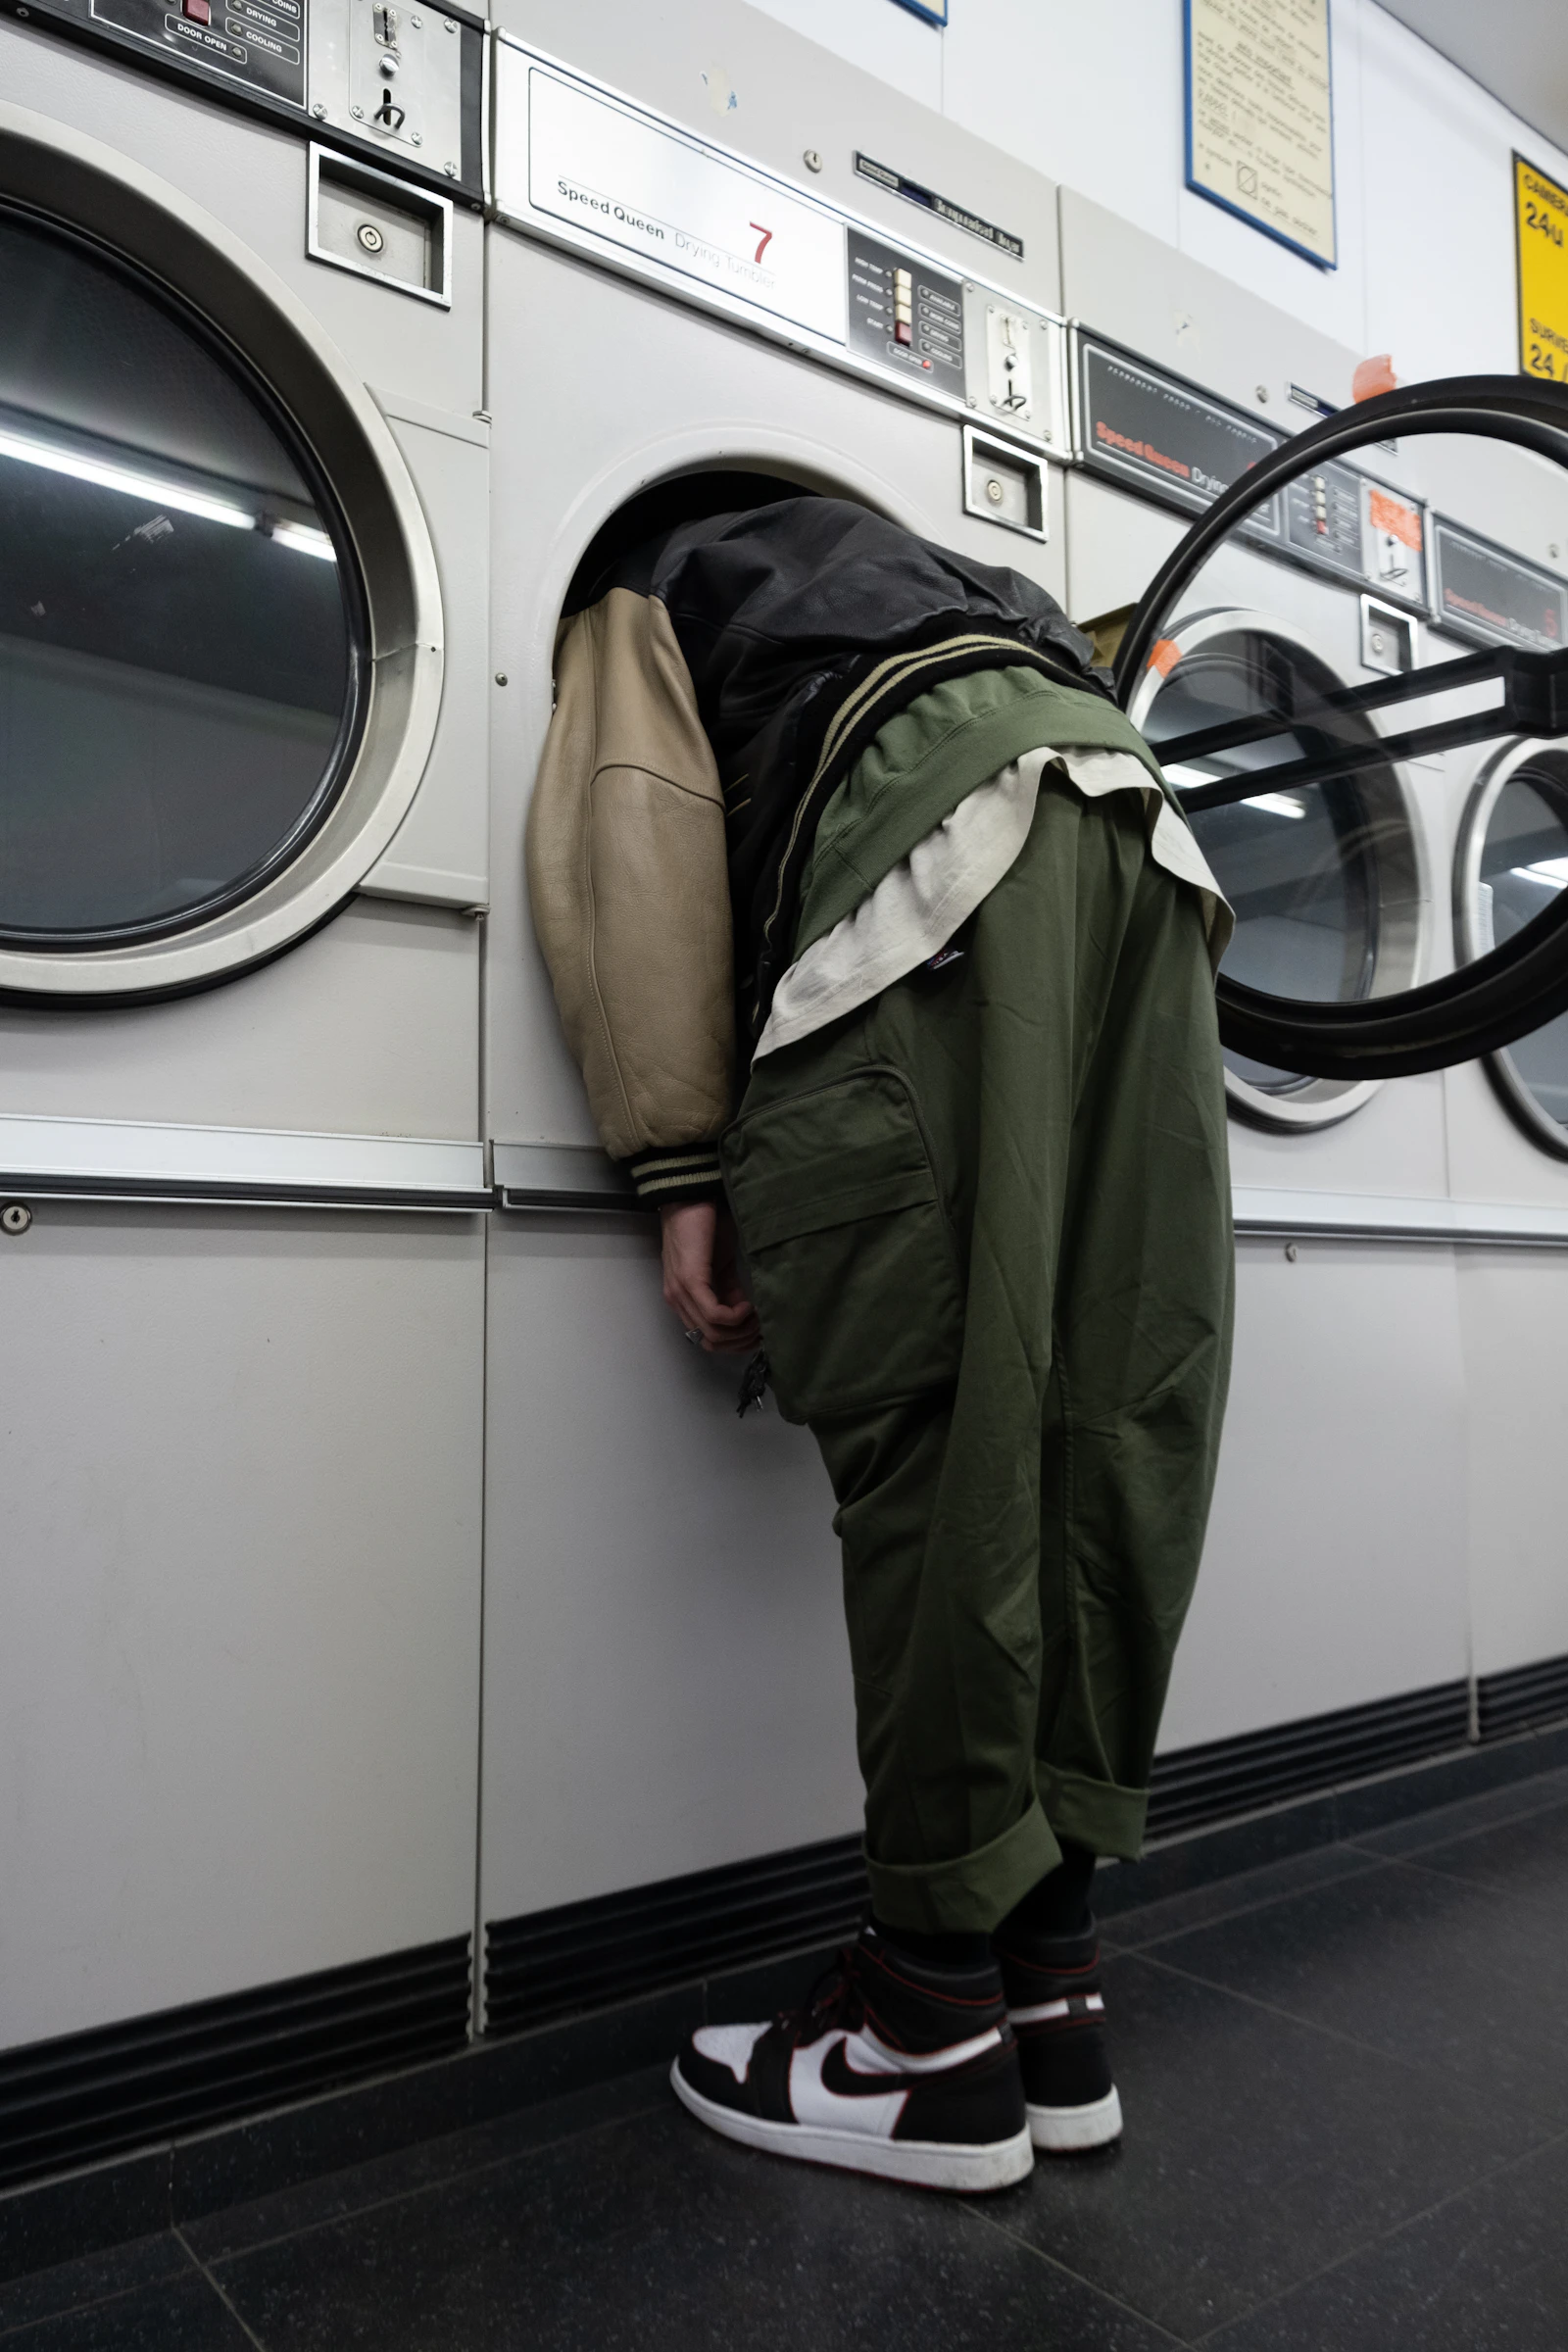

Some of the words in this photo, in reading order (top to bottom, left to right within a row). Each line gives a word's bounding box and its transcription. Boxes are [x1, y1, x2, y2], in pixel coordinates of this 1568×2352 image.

[246, 7, 277, 26] DRYING
[177, 24, 203, 40] DOOR
[204, 36, 227, 51] OPEN
[246, 30, 282, 53] COOLING
[558, 180, 610, 215] Speed
[613, 206, 665, 240] Queen
[675, 232, 719, 268] Drying
[725, 256, 776, 290] Tumbler
[750, 221, 773, 265] 7
[1096, 420, 1144, 456] Speed
[1144, 443, 1190, 478] Queen
[1545, 608, 1557, 638] 5
